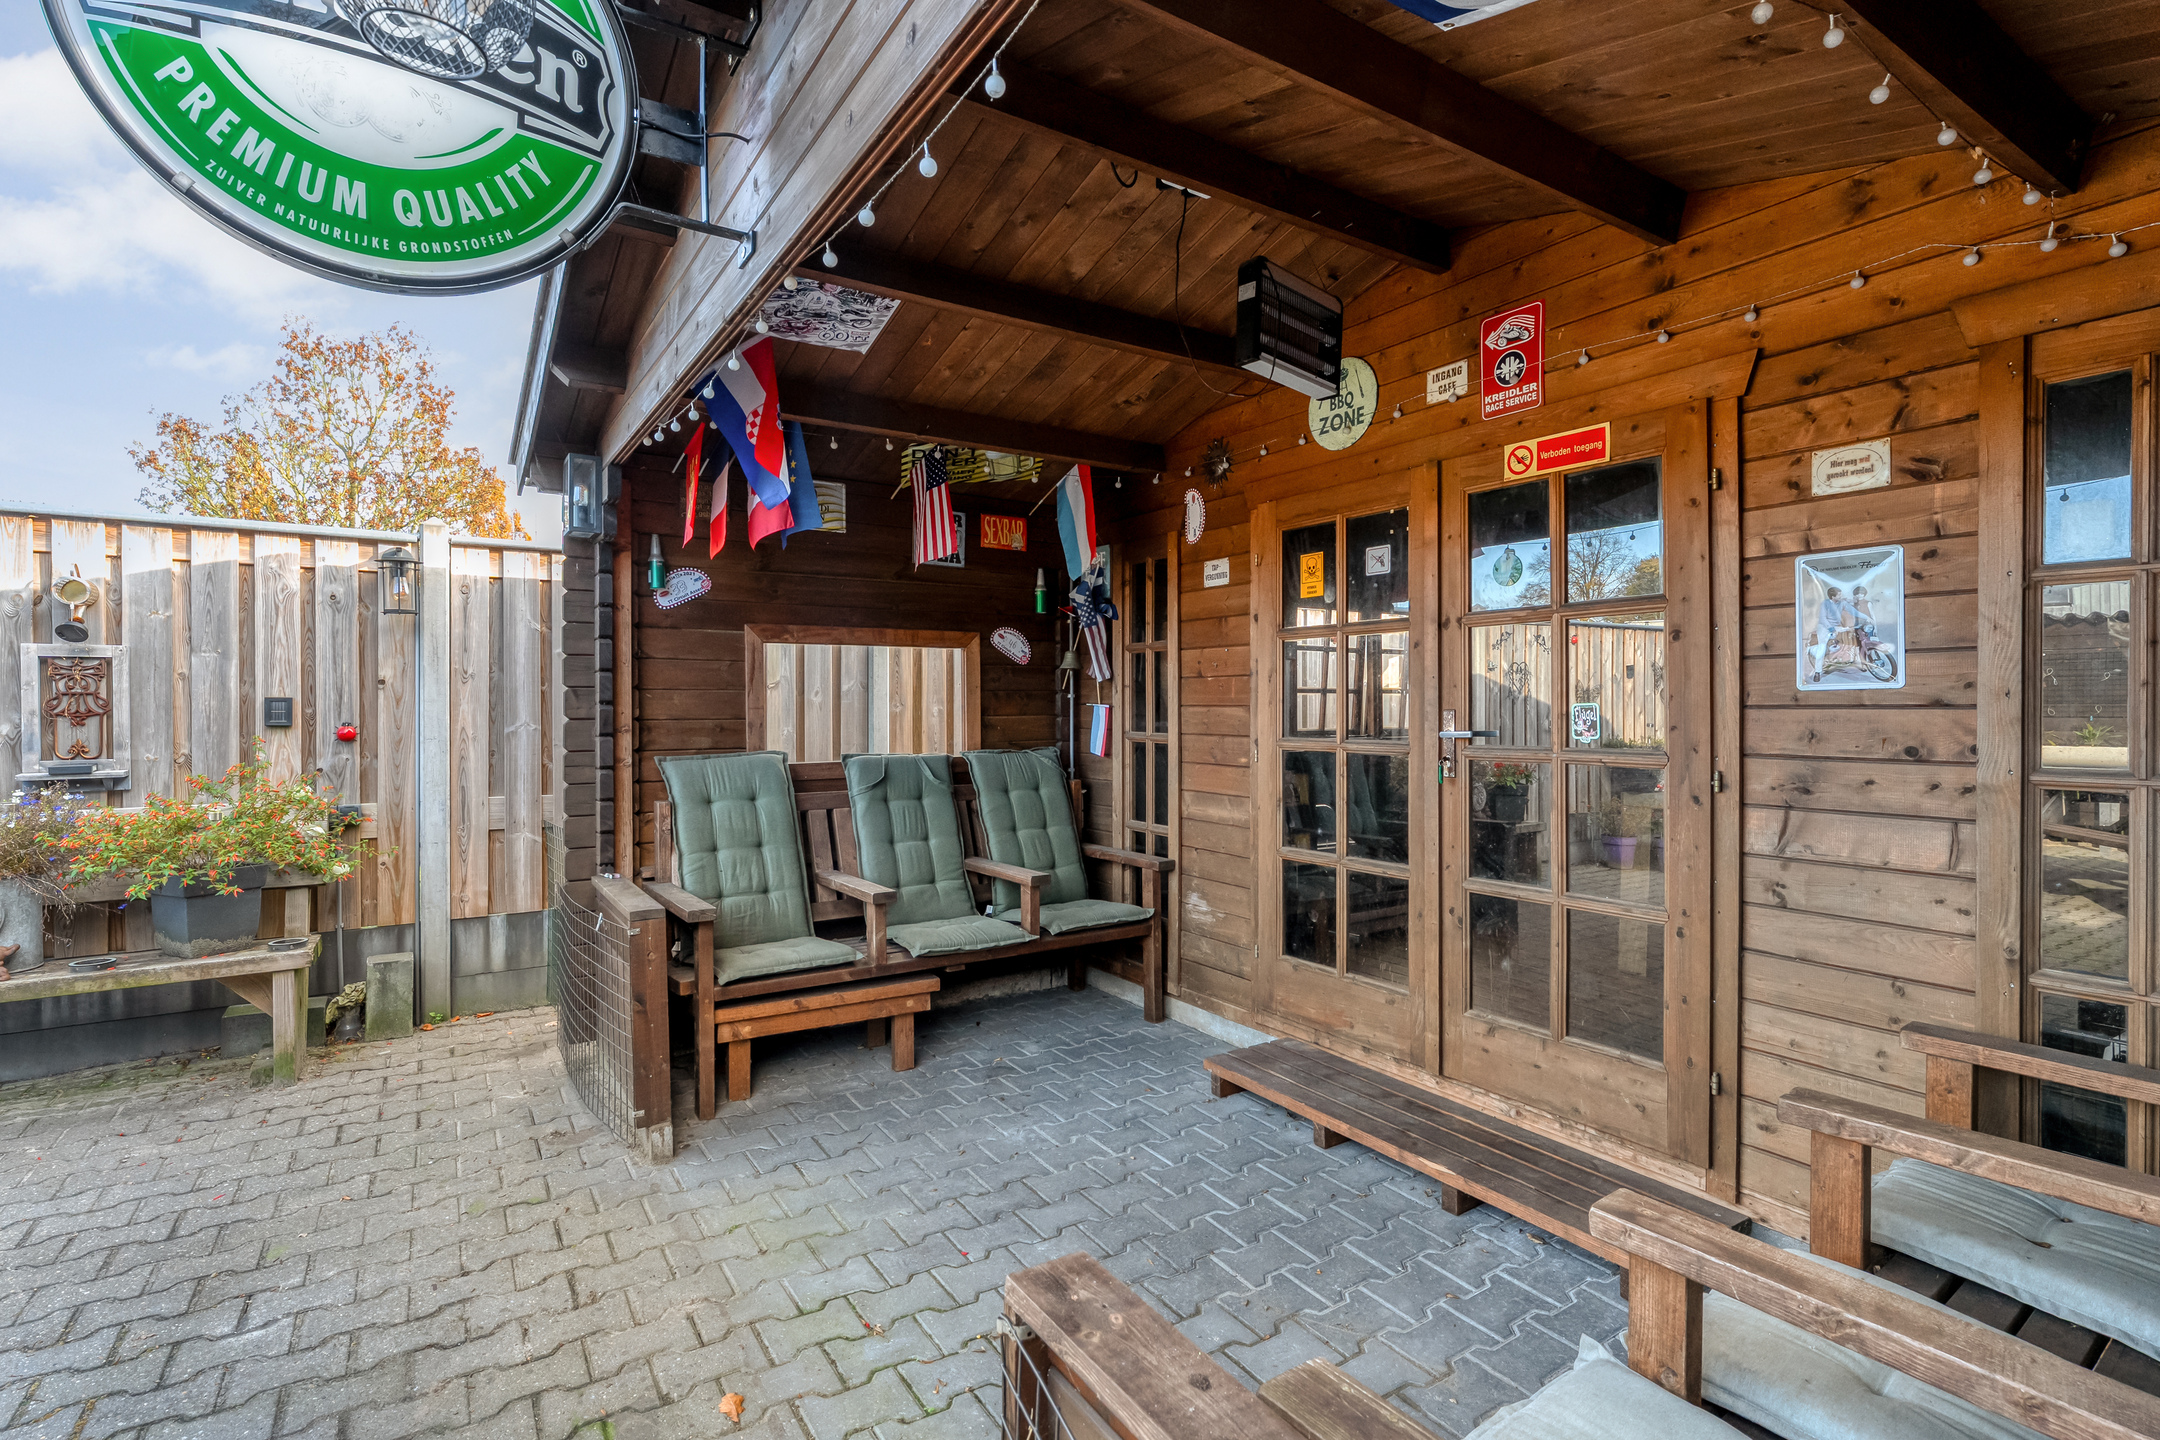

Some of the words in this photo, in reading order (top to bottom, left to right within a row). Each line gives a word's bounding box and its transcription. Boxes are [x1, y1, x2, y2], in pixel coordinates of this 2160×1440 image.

[153, 55, 367, 220] PREMIUM
[393, 150, 551, 228] QUALITY
[204, 159, 267, 206] ZUIVER
[273, 202, 390, 251] NATUURLIJKE
[398, 228, 514, 254] GRONDSTOFFEN
[1432, 365, 1463, 384] INGANG
[1329, 391, 1354, 411] BBQ
[1485, 382, 1538, 405] KREIDLER
[1485, 401, 1504, 413] RACE
[1505, 391, 1538, 408] SERVICE
[1319, 406, 1364, 436] ZONE
[1540, 447, 1571, 459] Verboden
[1573, 441, 1603, 453] toegang
[1830, 460, 1844, 468] Hier
[1845, 458, 1858, 467] mag
[984, 516, 1024, 546] SEXBAR
